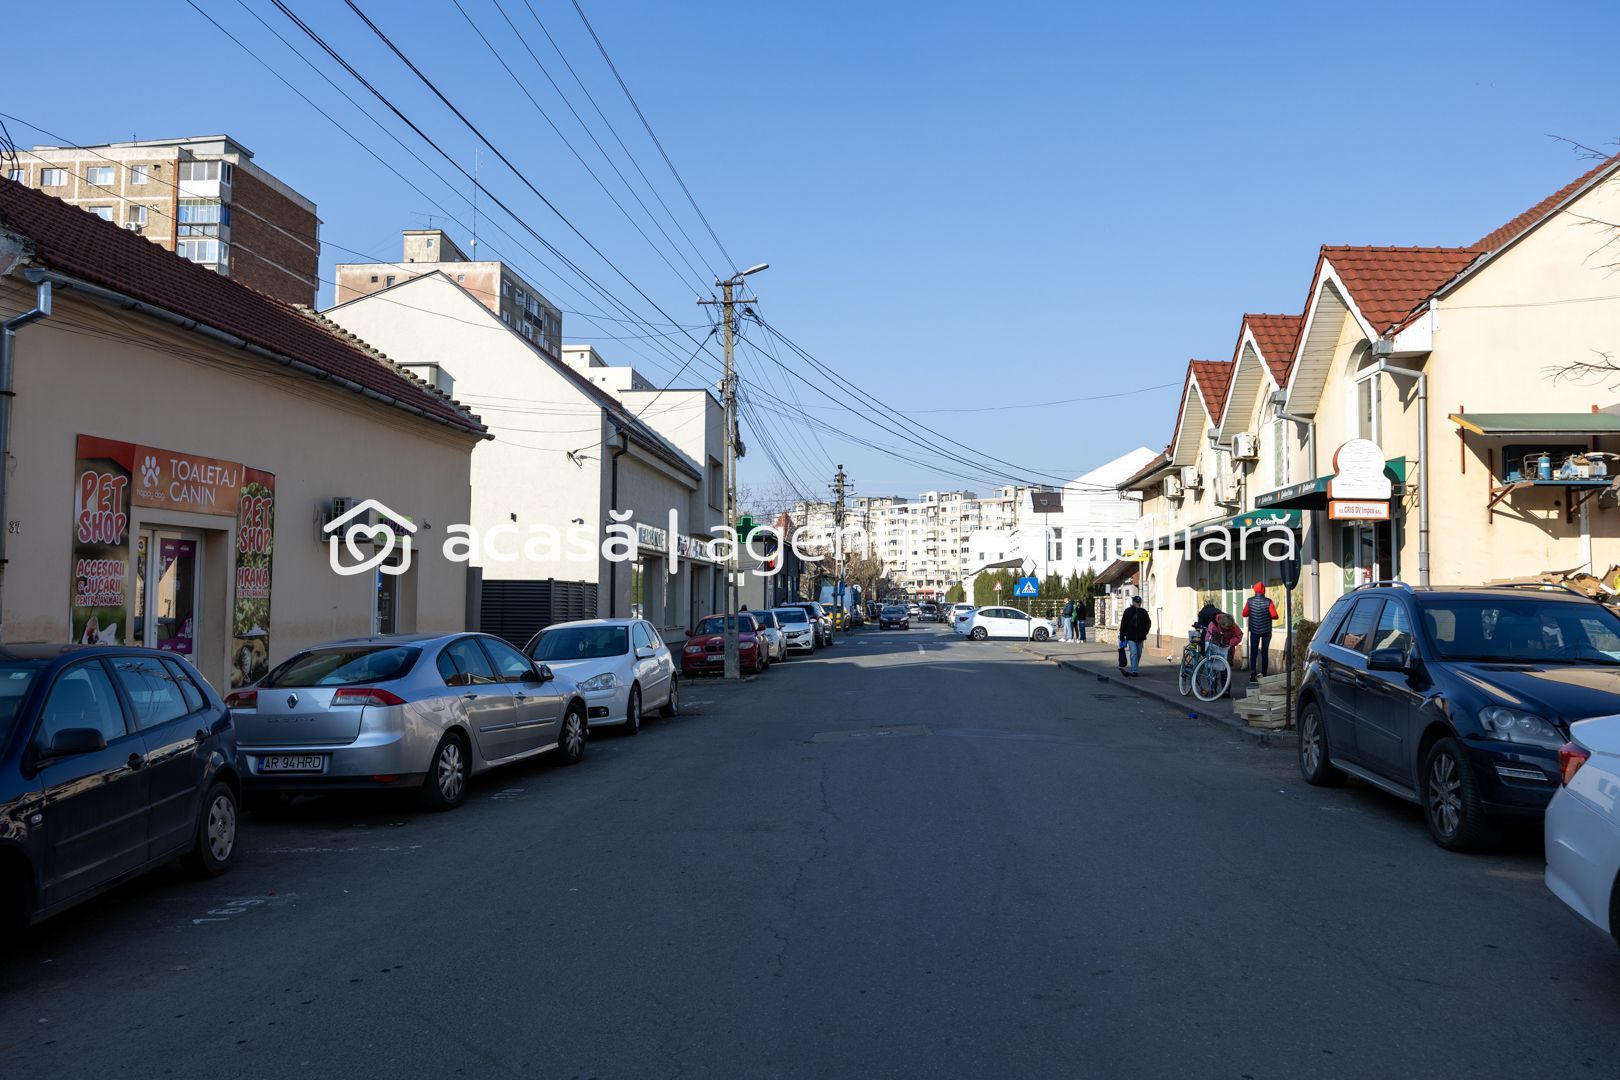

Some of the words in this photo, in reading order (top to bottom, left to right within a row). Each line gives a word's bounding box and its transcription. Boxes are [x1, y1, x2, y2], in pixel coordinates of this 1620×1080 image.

[170, 459, 237, 488] TOALETAJ
[81, 471, 128, 512] PET
[169, 481, 216, 505] CANIN
[240, 494, 272, 528] PET
[78, 509, 127, 545] SHOP
[239, 526, 272, 553] SHOP
[76, 559, 124, 577] ACCESORII
[265, 757, 280, 769] AR
[283, 757, 295, 769] 94
[297, 756, 321, 768] HRD
